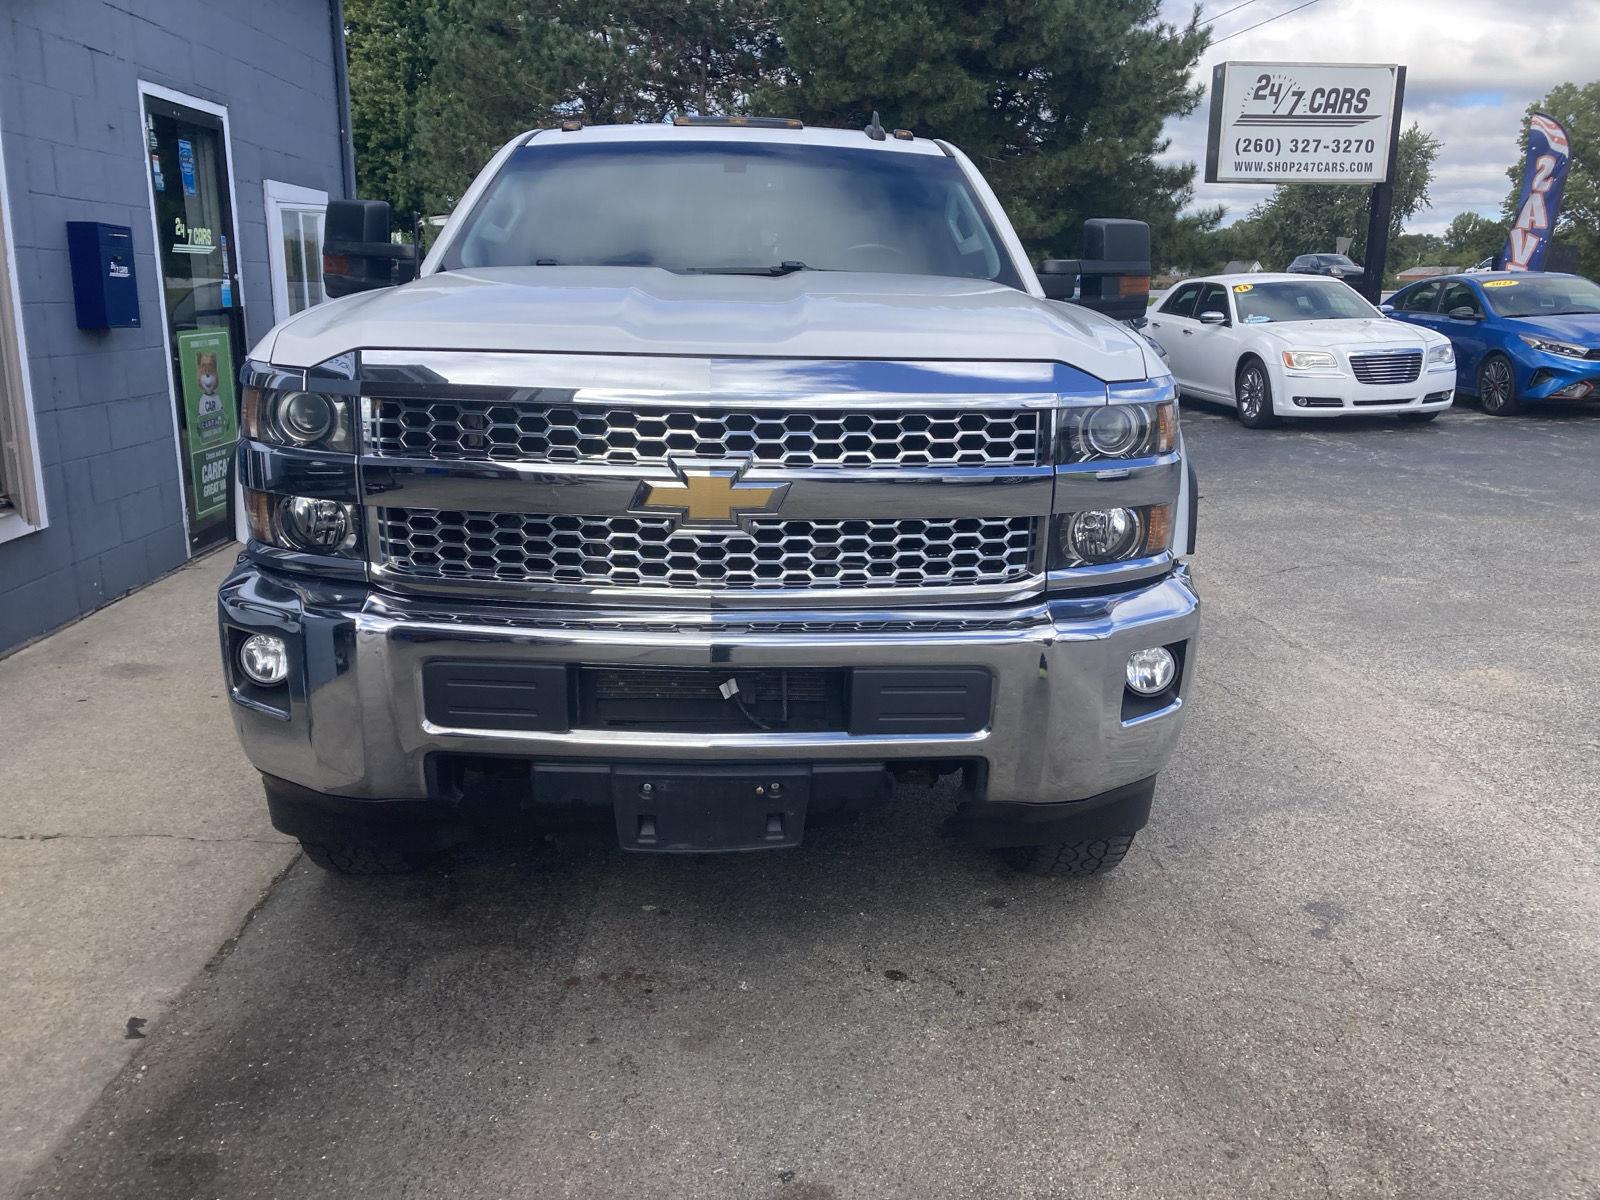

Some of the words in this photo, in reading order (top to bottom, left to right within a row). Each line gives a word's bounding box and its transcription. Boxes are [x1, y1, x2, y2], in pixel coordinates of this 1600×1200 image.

[1309, 87, 1371, 114] CARS
[1235, 138, 1282, 156] (260)
[1289, 138, 1375, 154] 327-3270
[1234, 161, 1373, 173] WWW.SHOP247CARS.COM
[193, 227, 212, 246] CARS
[205, 400, 217, 412] CAR
[202, 457, 230, 484] CARFA
